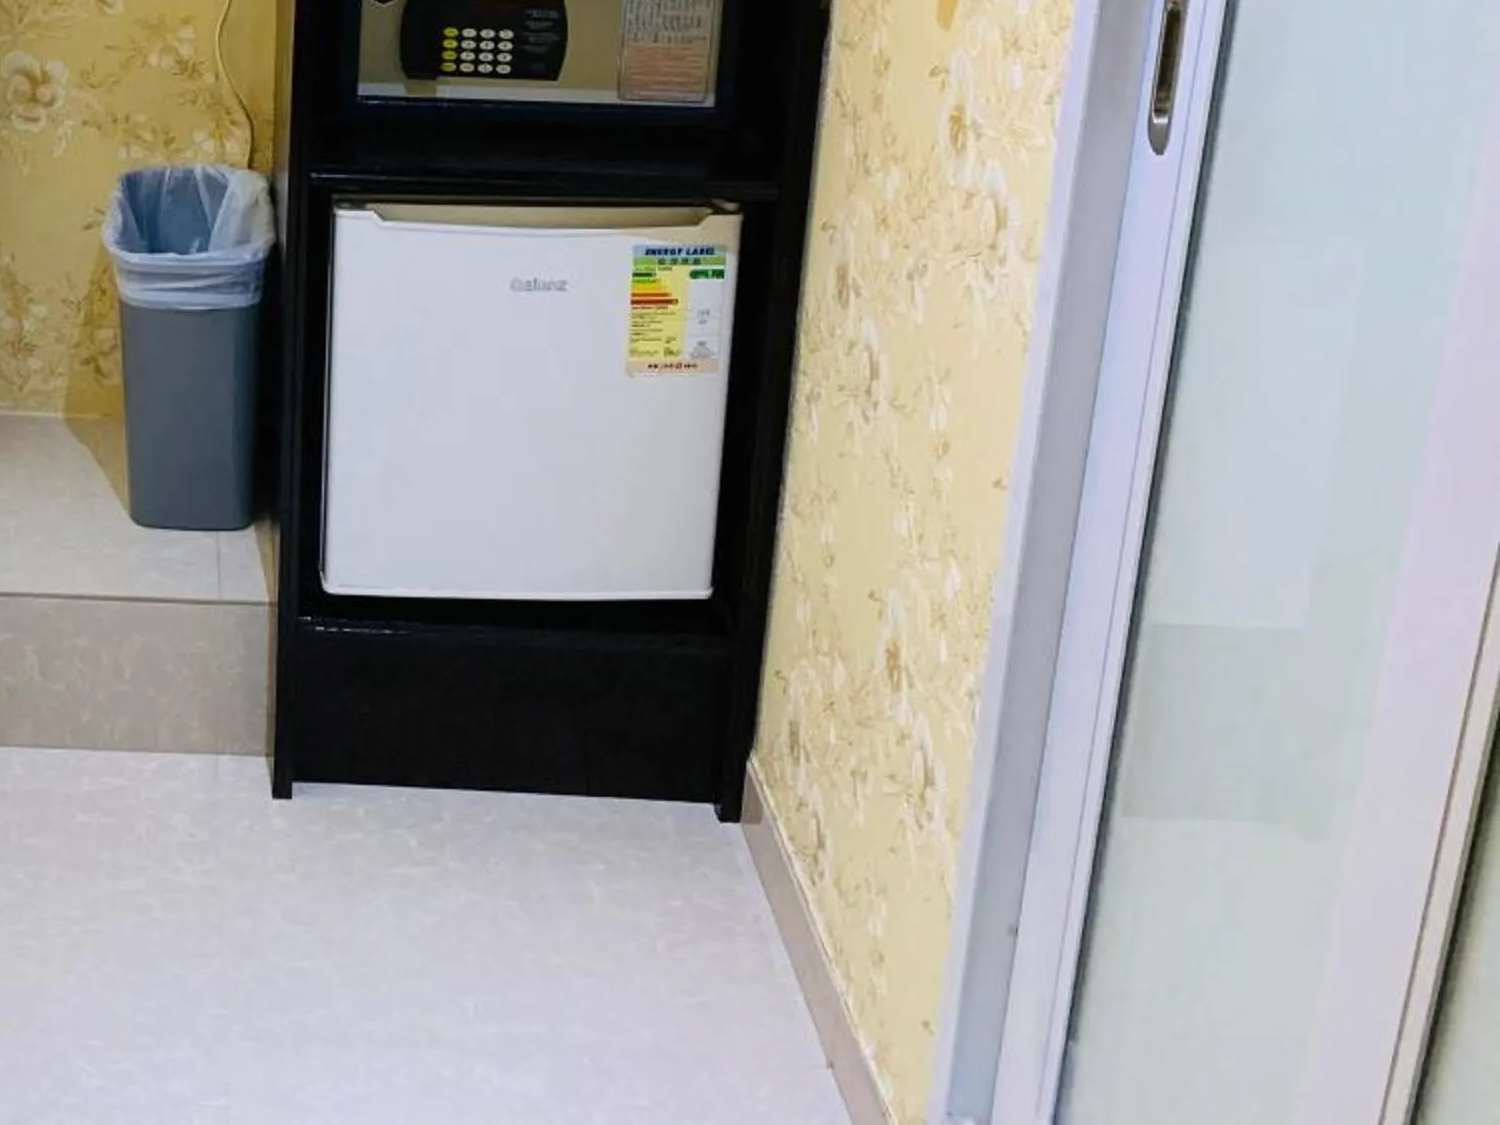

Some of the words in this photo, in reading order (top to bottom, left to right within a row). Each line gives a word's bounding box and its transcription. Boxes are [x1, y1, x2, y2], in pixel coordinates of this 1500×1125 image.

[644, 248, 683, 256] ENERGY
[686, 247, 715, 256] LABEL
[510, 275, 568, 292] Galanz
